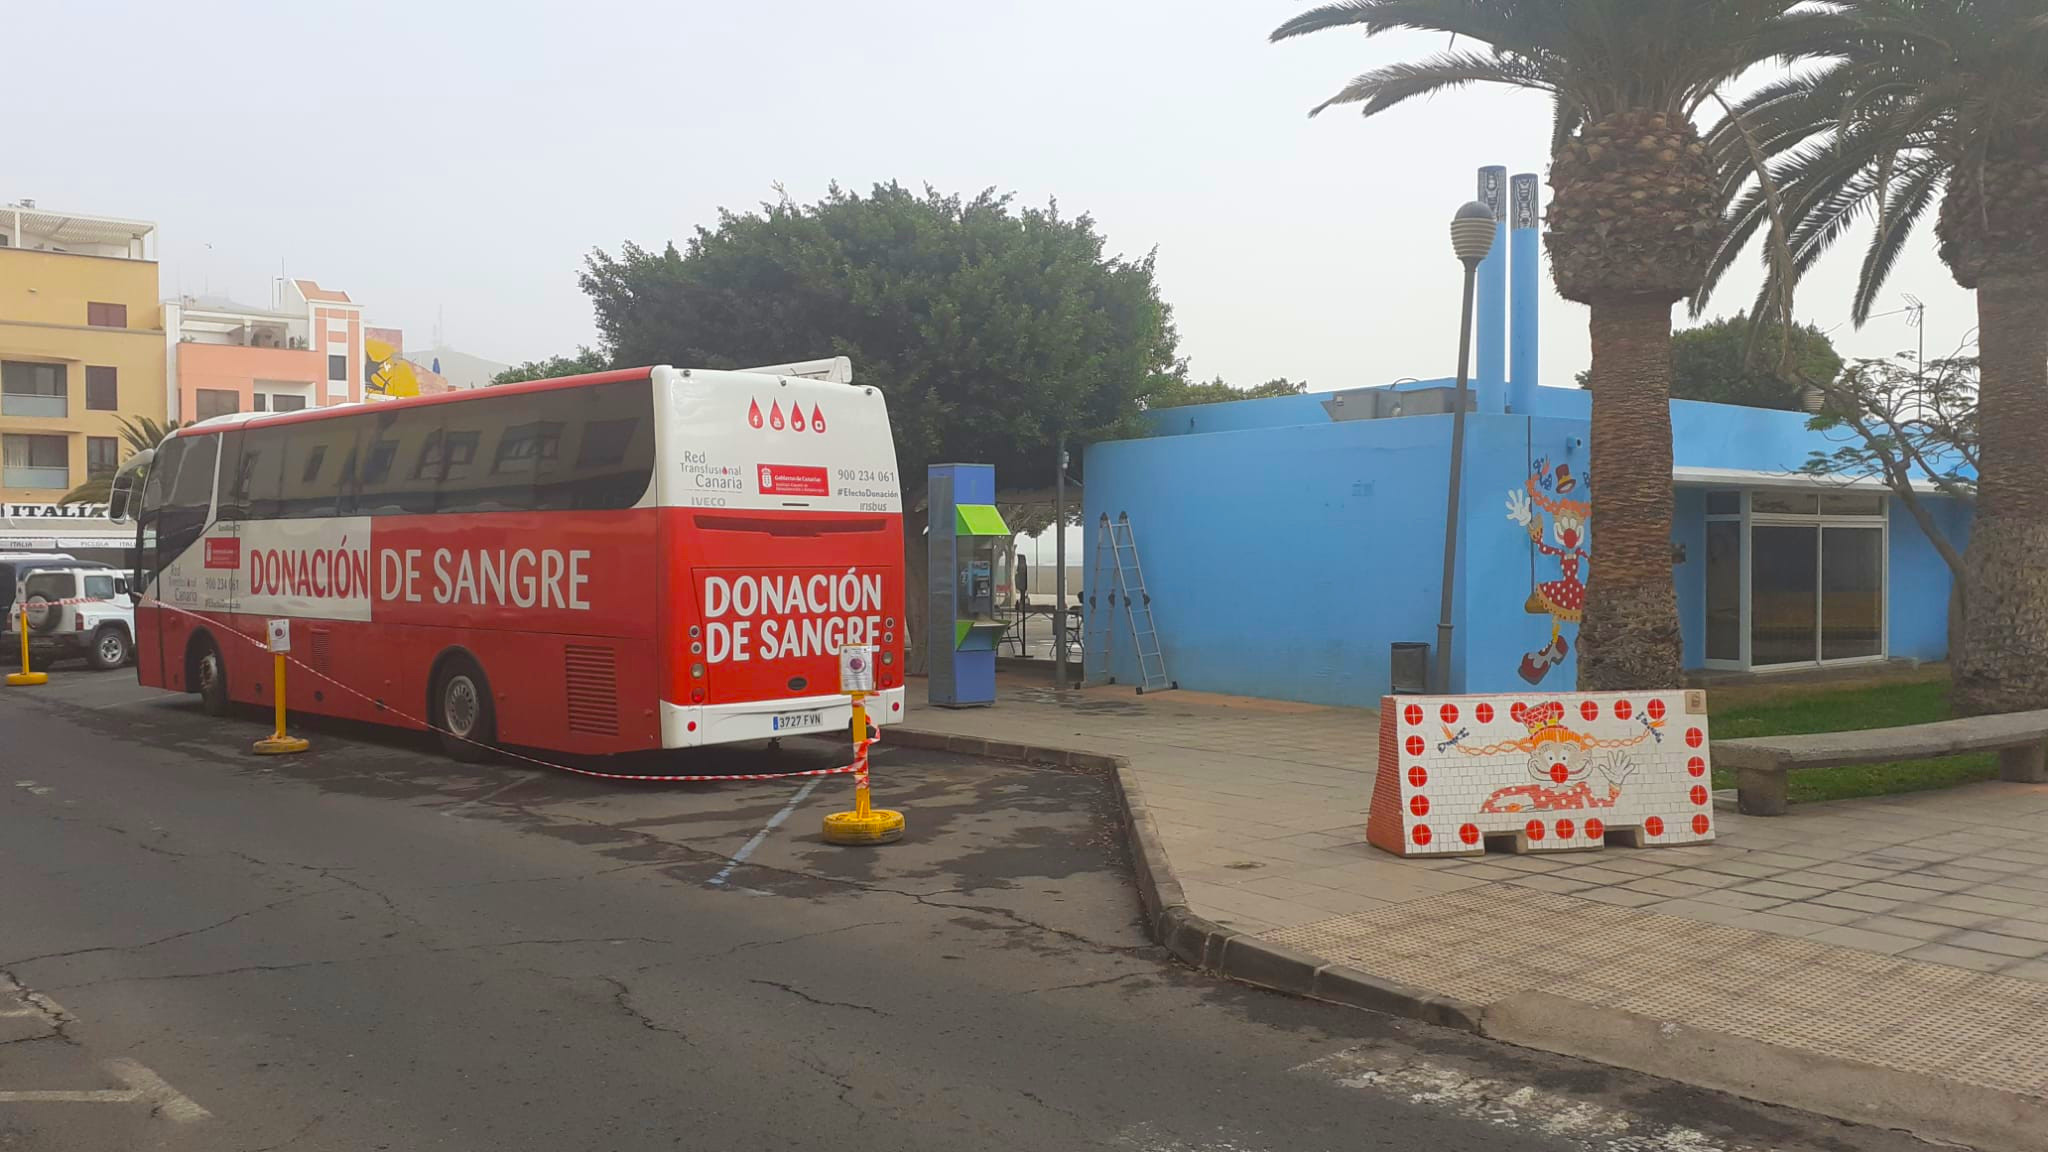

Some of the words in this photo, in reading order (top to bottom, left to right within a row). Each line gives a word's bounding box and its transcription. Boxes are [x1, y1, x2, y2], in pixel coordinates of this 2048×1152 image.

[684, 450, 706, 463] Red
[695, 474, 742, 489] Canaria
[838, 469, 855, 480] 900
[858, 470, 875, 481] 234
[878, 471, 895, 482] 061
[837, 488, 899, 498] #EfectoDonación
[691, 497, 726, 506] IVECO
[10, 505, 109, 518] ITALIA
[251, 535, 369, 598] DONACIÓN
[381, 548, 421, 602] DE
[433, 548, 590, 610] SANGRE
[705, 566, 881, 618] DONACIÓN
[706, 620, 750, 663] DE
[760, 616, 881, 660] SANGRE
[780, 716, 802, 728] 3727
[804, 714, 821, 725] FVN
